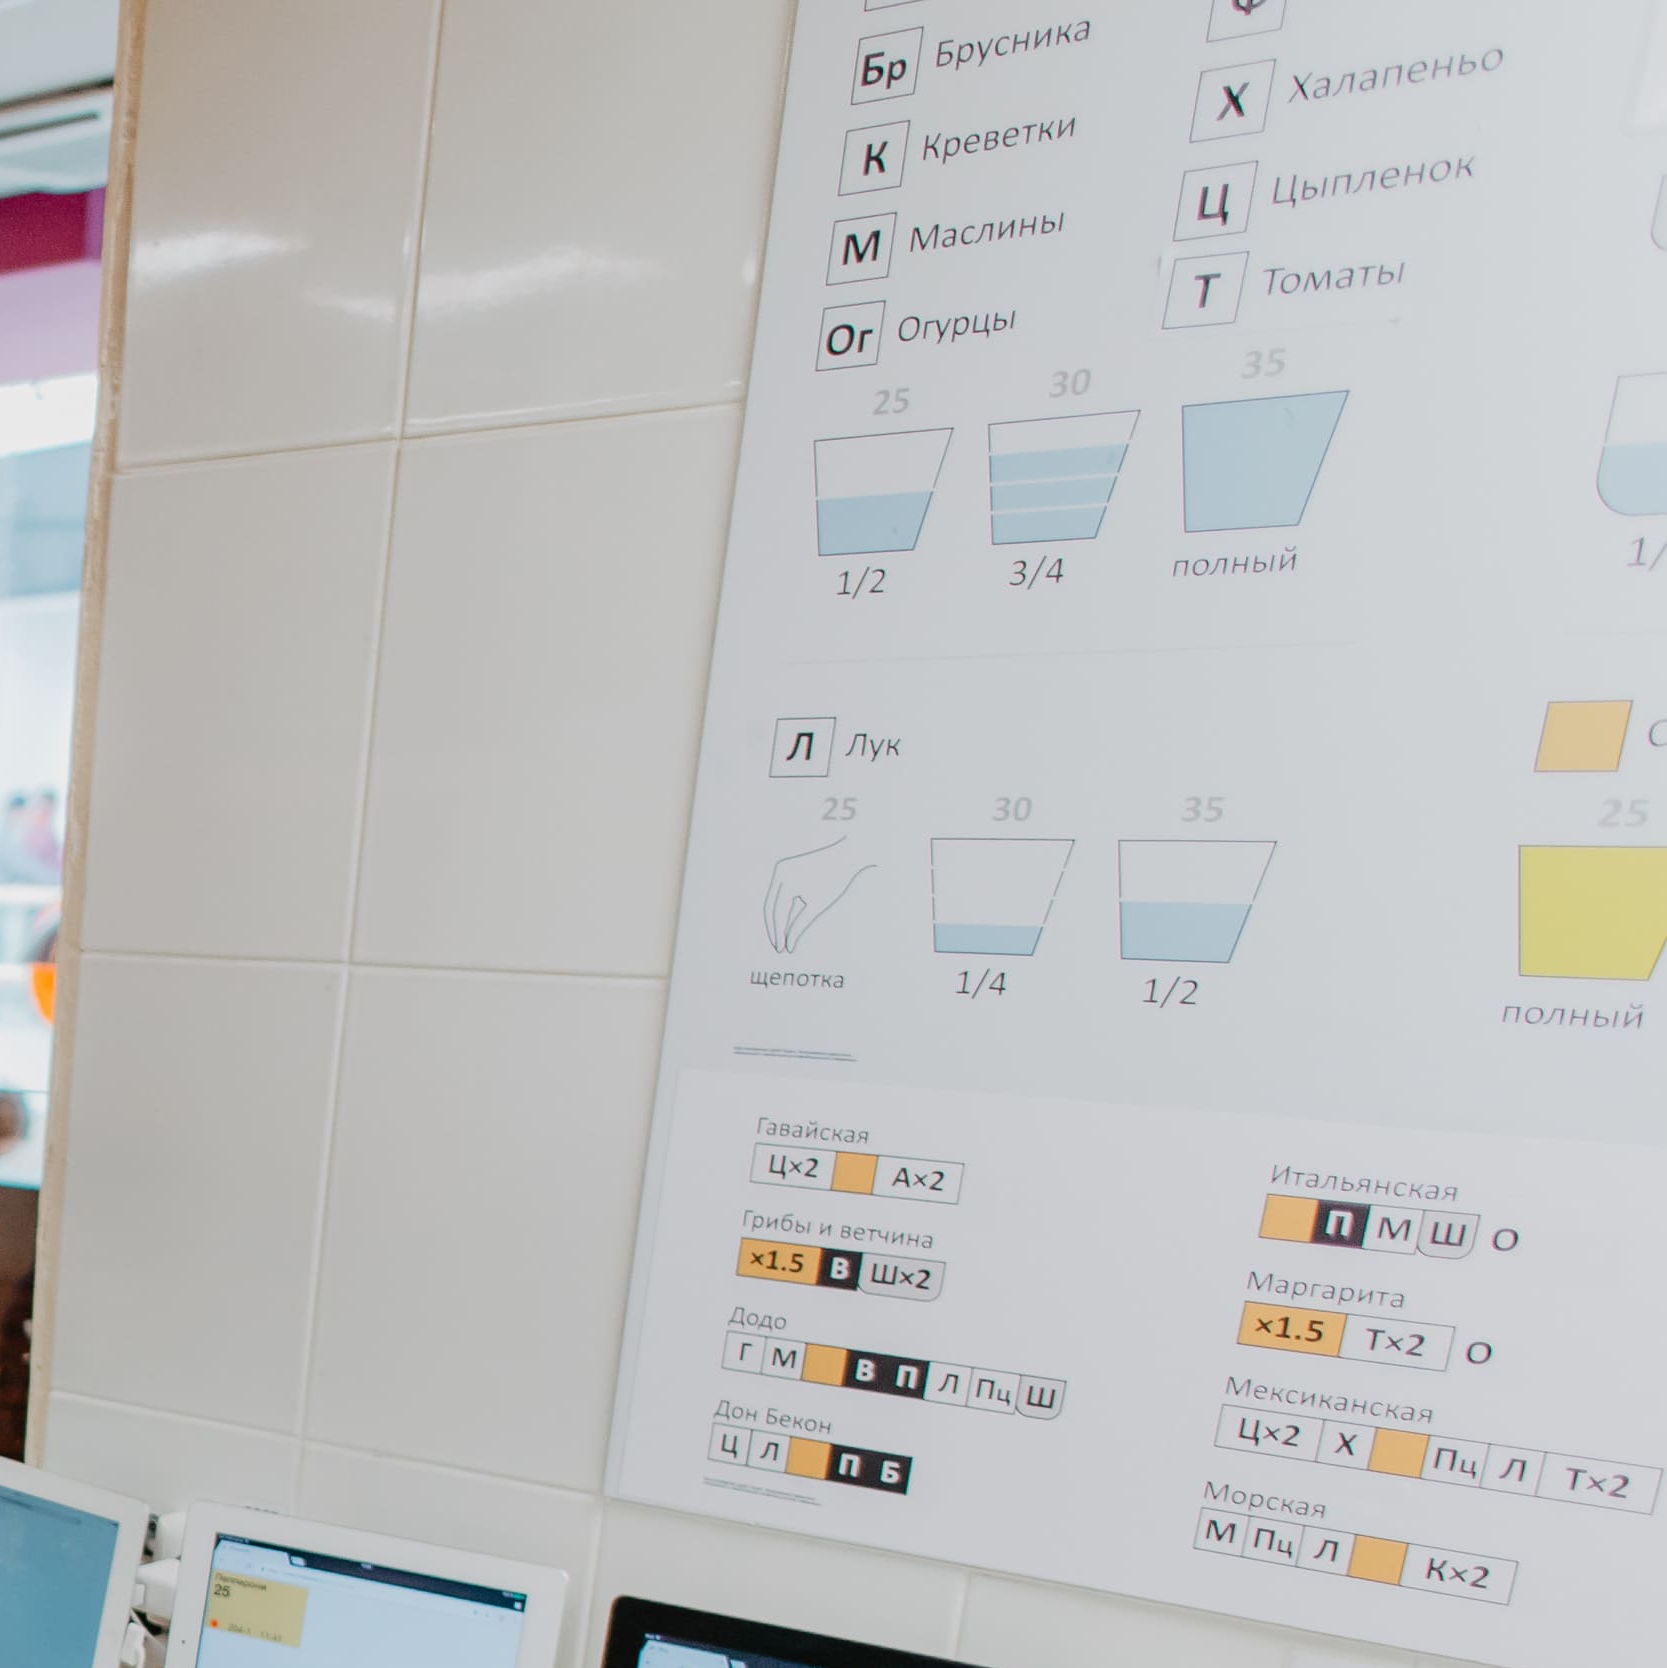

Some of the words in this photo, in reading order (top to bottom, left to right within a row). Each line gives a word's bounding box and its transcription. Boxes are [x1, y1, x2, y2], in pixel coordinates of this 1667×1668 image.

[861, 51, 907, 90] Бр
[935, 20, 1091, 71] Брусника
[1219, 82, 1249, 120] Х
[1287, 48, 1504, 104] Халапеньо
[863, 140, 889, 176] К
[922, 117, 1076, 165] Креветки
[1197, 183, 1229, 226] Ц
[1272, 157, 1474, 209] Цыпленок
[842, 229, 881, 266] М
[909, 212, 1065, 253] Маслины
[1194, 272, 1222, 309] Т
[1263, 262, 1405, 296] Томаты
[826, 323, 874, 356] Ог
[898, 310, 1016, 345] Огурцы
[1240, 347, 1286, 380] 35
[1048, 368, 1092, 399] 30
[872, 386, 910, 417] 25
[1009, 555, 1064, 590] 3/4
[1172, 545, 1297, 577] полный
[836, 566, 886, 600] 1/2
[786, 731, 814, 761] Л
[845, 732, 901, 763] Лук
[821, 796, 858, 822] 25
[991, 796, 1033, 822] 30
[1181, 795, 1225, 823] 35
[1597, 798, 1650, 828] 25
[750, 971, 845, 989] щепотка
[955, 968, 1007, 1000] 1/4
[1142, 976, 1199, 1009] 1/2
[1502, 1004, 1644, 1029] полный
[756, 1116, 870, 1145] Гавайская
[1271, 1164, 1458, 1201] Итальянская
[742, 1209, 812, 1234] Грибы
[819, 1223, 833, 1237] и
[841, 1226, 933, 1249] ветчина
[1325, 1209, 1354, 1239] П
[1377, 1216, 1412, 1241] М
[1430, 1221, 1467, 1247] Ш
[830, 1256, 850, 1280] В
[1246, 1271, 1405, 1309] Маргарита
[727, 1306, 787, 1332] Додо
[737, 1340, 755, 1365] Г
[772, 1347, 798, 1369] М
[855, 1358, 876, 1382] В
[895, 1364, 920, 1390] П
[937, 1373, 959, 1395] Л
[975, 1378, 1011, 1407] Пц
[1026, 1385, 1056, 1410] Ш
[712, 1399, 758, 1422] Дон
[765, 1407, 832, 1435] Бекон
[1225, 1375, 1433, 1424] Мексиканская
[720, 1433, 738, 1459] Ц
[759, 1441, 780, 1462] Л
[838, 1452, 862, 1478] П
[880, 1460, 901, 1484] Б
[1334, 1432, 1358, 1456] Х
[1430, 1447, 1477, 1484] Пц
[1498, 1458, 1528, 1482] Л
[1203, 1480, 1326, 1519] Морская
[1205, 1519, 1237, 1544] М
[1253, 1527, 1293, 1559] Пц
[1313, 1539, 1340, 1563] Л
[213, 1584, 231, 1598] 25
